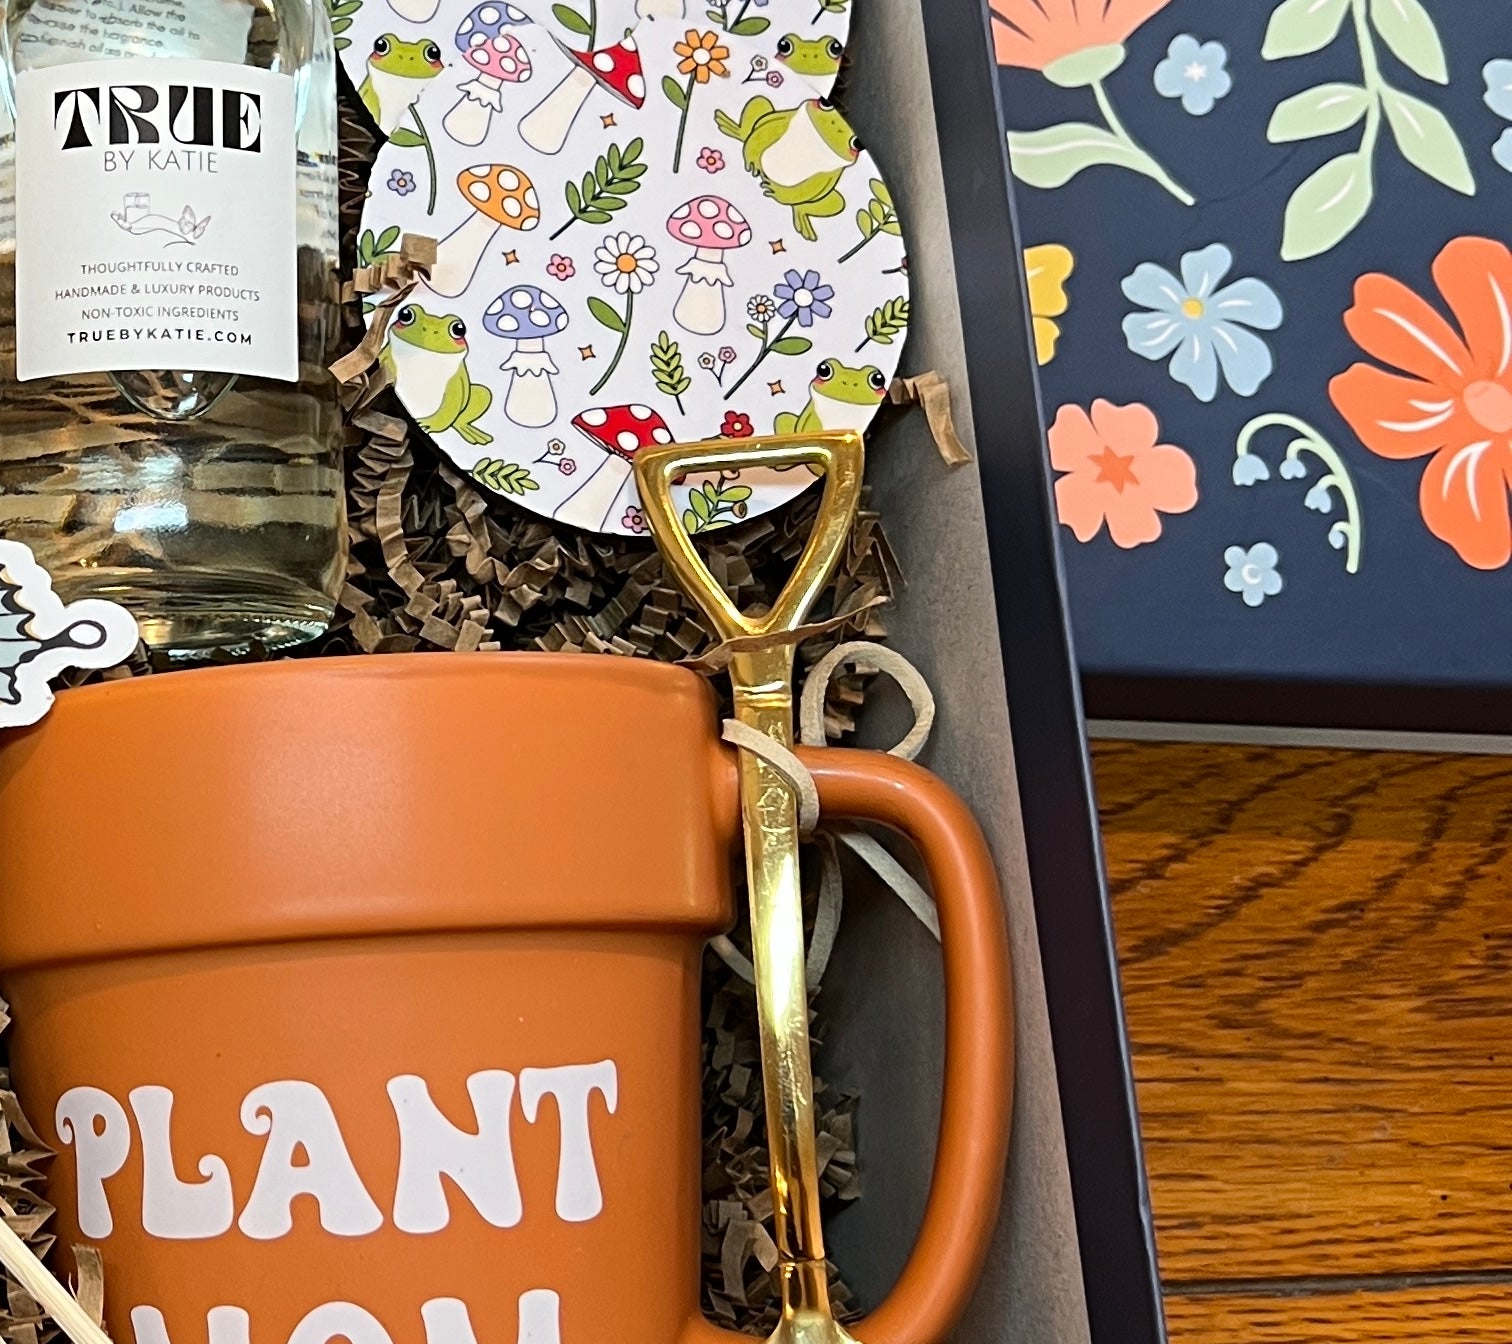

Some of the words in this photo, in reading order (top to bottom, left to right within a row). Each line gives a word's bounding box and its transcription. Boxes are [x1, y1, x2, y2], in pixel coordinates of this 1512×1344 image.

[54, 85, 261, 153] TRUE
[104, 149, 135, 172] BY
[148, 149, 218, 173] KATIE
[81, 261, 183, 275] THOUGHTFULLY
[186, 261, 239, 276] CRAFTED
[55, 283, 127, 300] HANDMADE
[131, 283, 141, 295] &
[144, 283, 195, 295] LUXURY
[198, 284, 260, 302] PRODUCTS
[81, 306, 153, 320] NON-TOXIC
[157, 306, 239, 322] INGREDIENTS
[67, 328, 252, 345] TRUEBYKATIE.COM
[55, 1058, 618, 1240] PLANT
